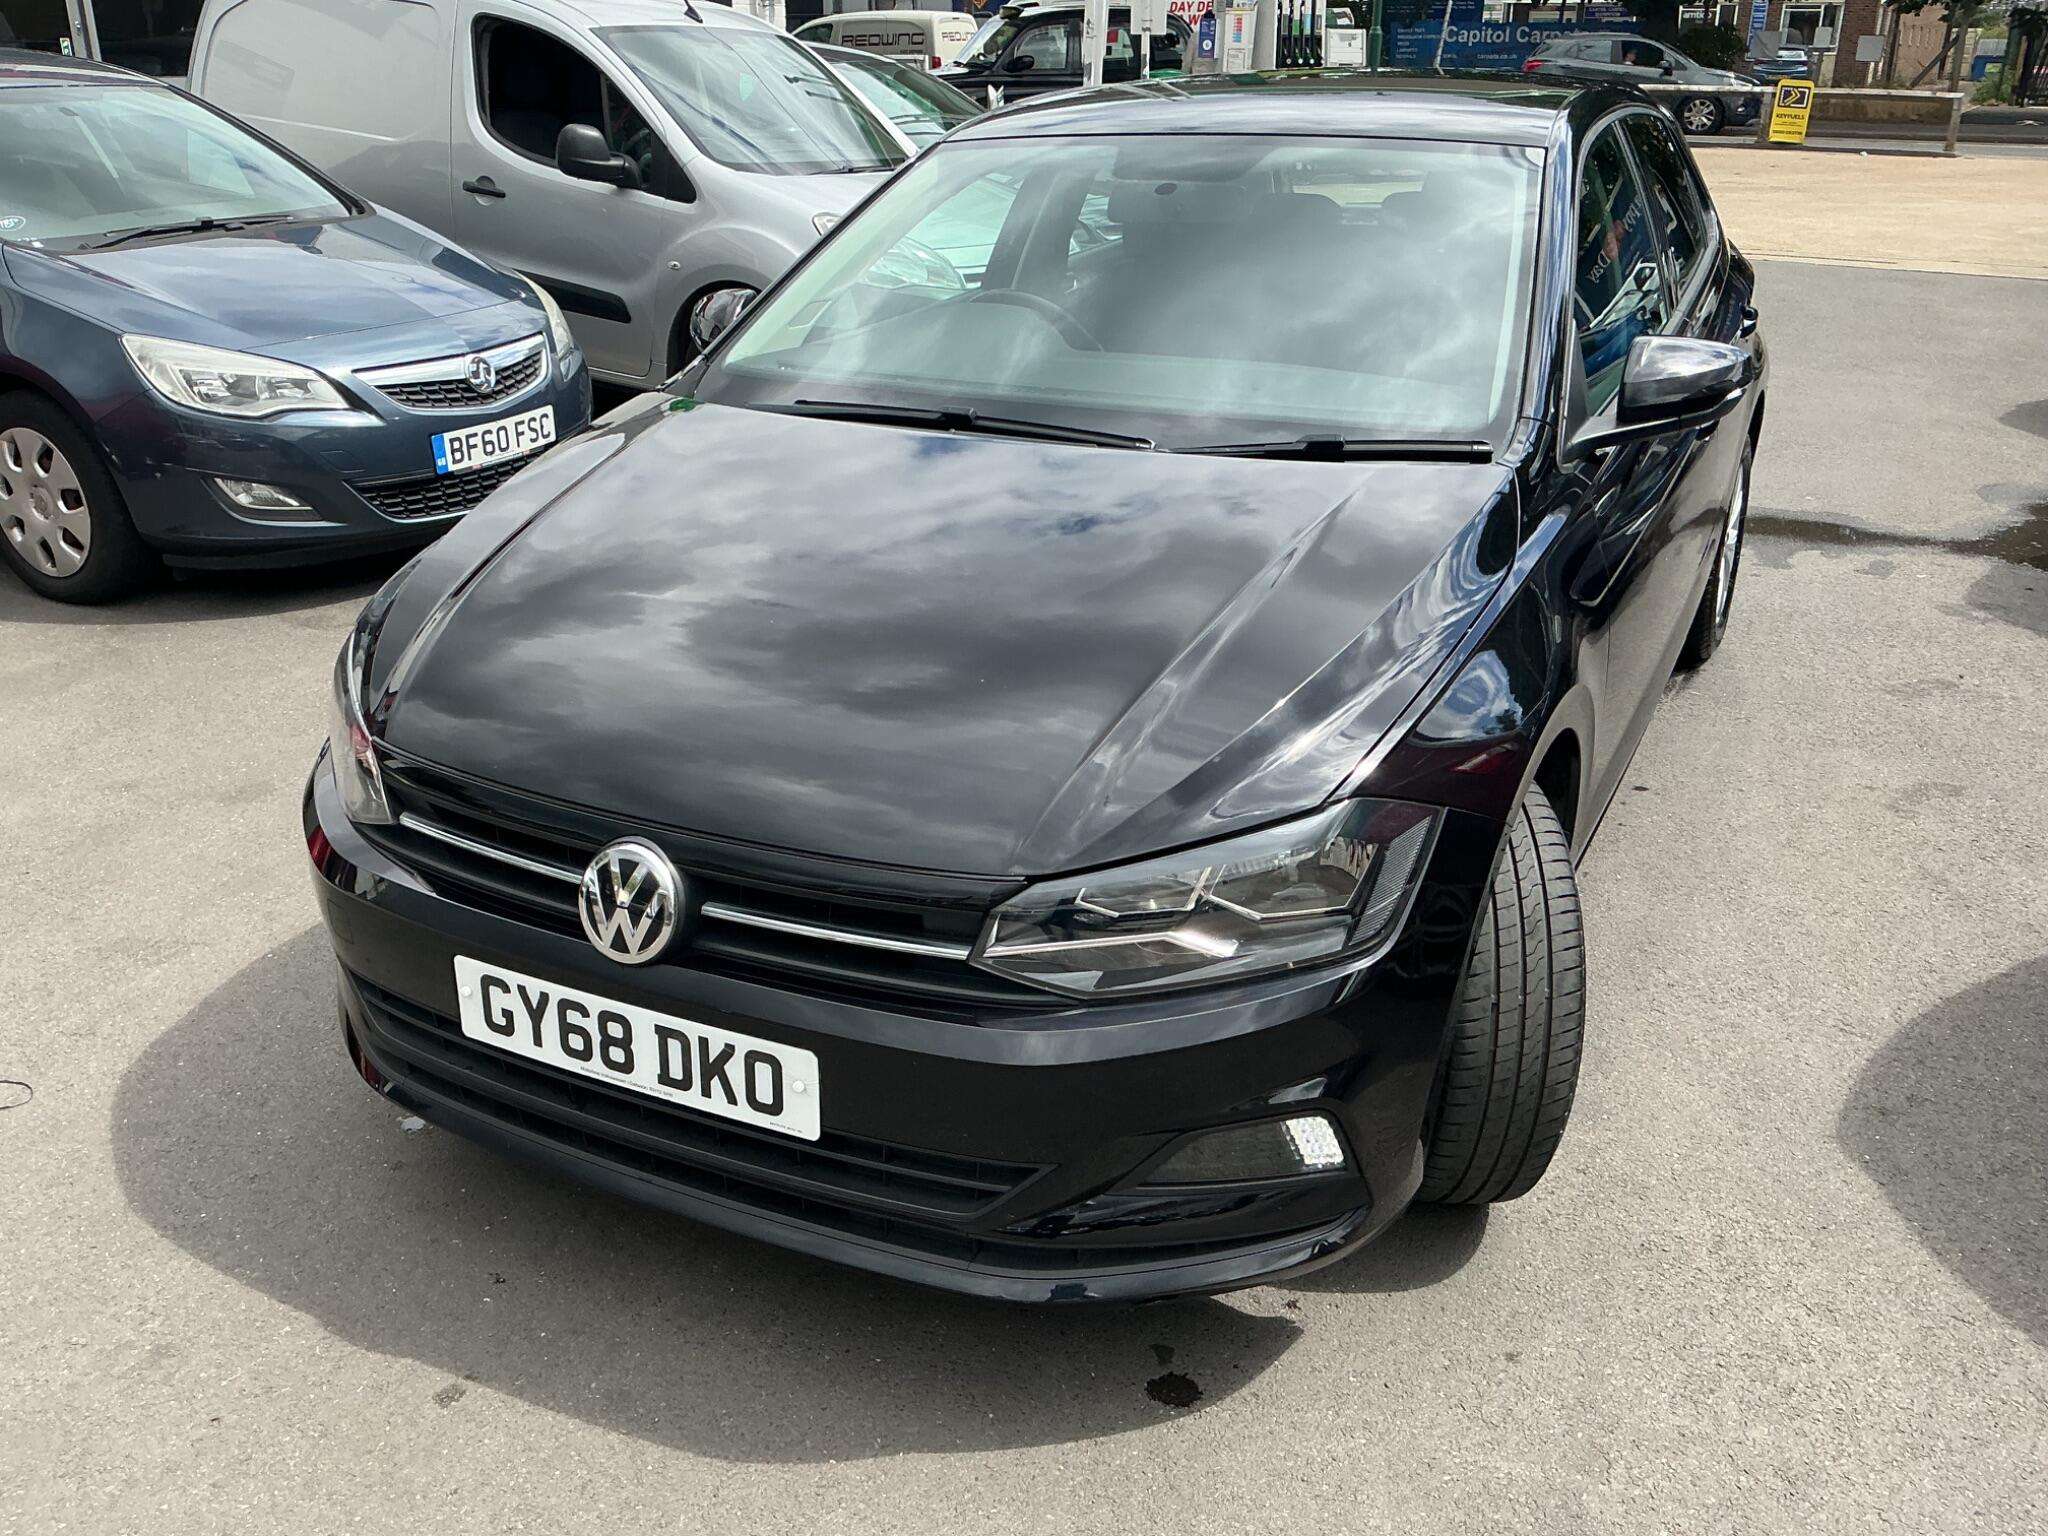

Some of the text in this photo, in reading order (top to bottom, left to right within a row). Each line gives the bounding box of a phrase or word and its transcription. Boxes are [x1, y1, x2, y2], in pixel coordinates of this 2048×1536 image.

[1170, 1, 1195, 12] DAY
[842, 32, 925, 47] REDWING
[1445, 25, 1510, 46] Capitol
[449, 412, 551, 465] BF60 FSC
[480, 973, 784, 1116] GY68 DKO
